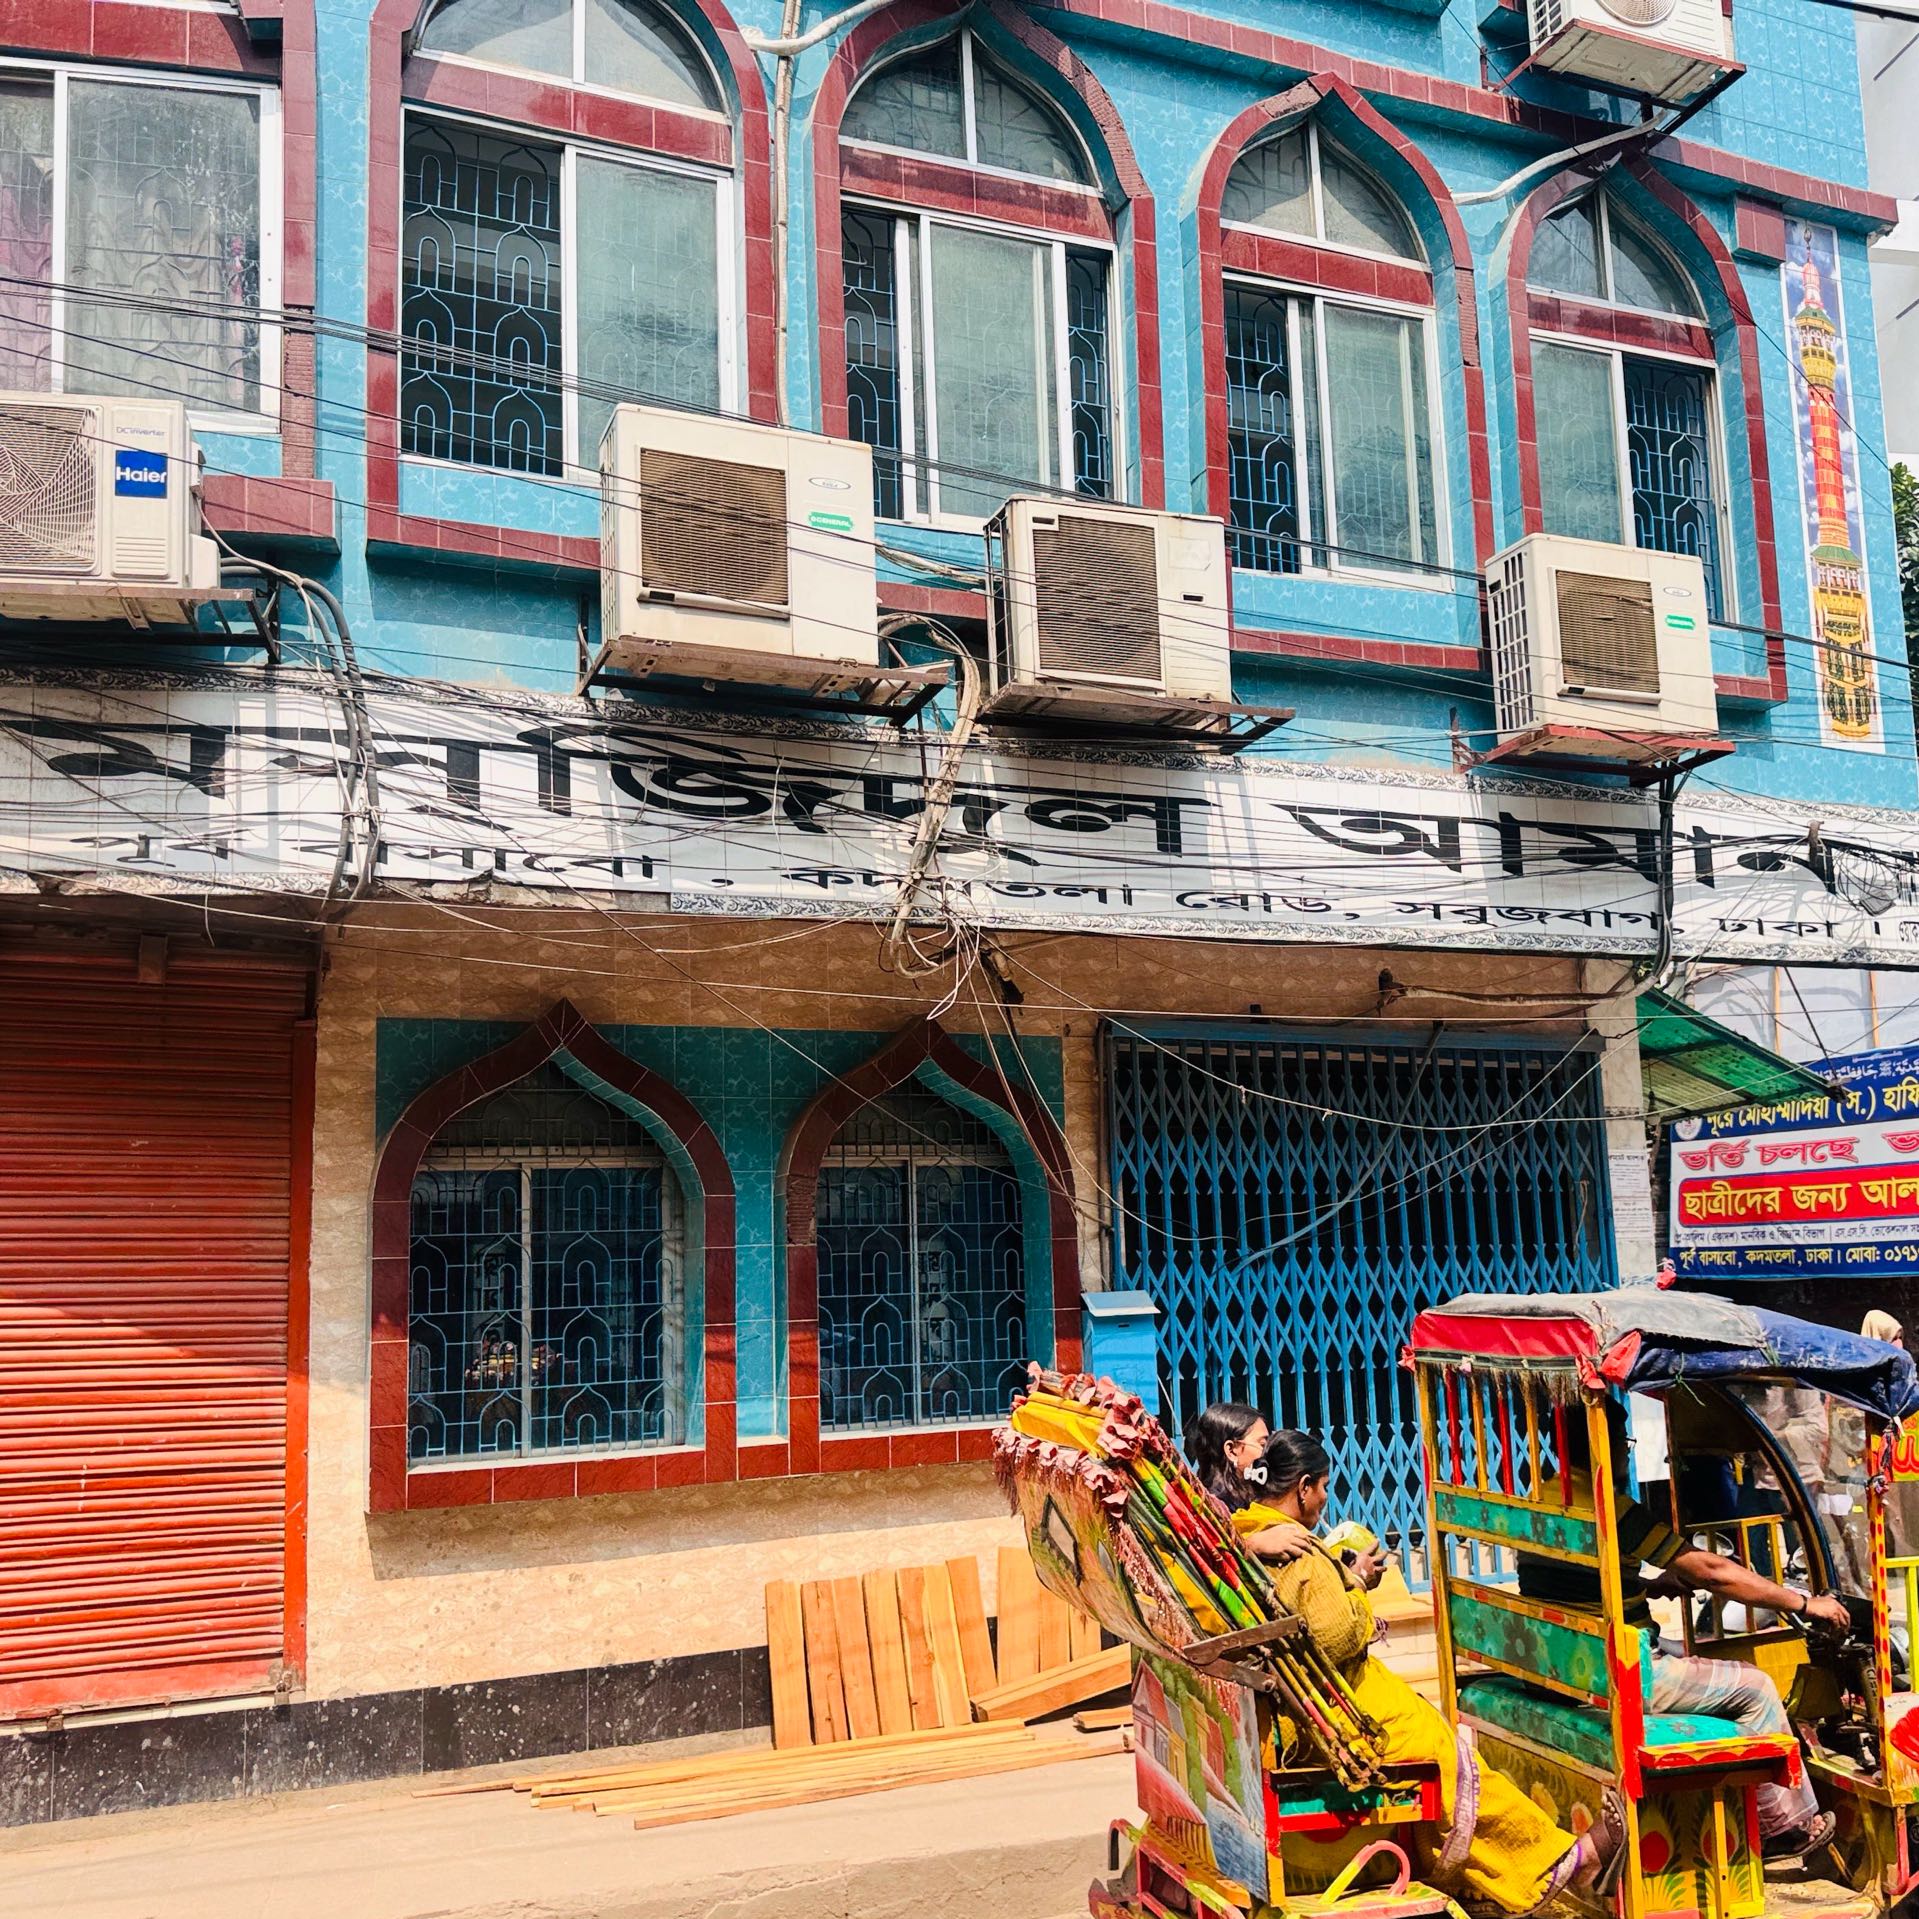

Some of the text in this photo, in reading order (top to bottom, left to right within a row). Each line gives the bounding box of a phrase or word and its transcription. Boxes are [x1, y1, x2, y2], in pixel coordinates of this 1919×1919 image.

[116, 466, 167, 483] Haier
[1679, 1138, 1751, 1171] ভর্তি
[1755, 1136, 1860, 1165] চলছে
[1683, 1181, 1784, 1220] ছাত্রীদের
[1789, 1183, 1852, 1213] জন্য
[1679, 1243, 1696, 1269] পূর্ব
